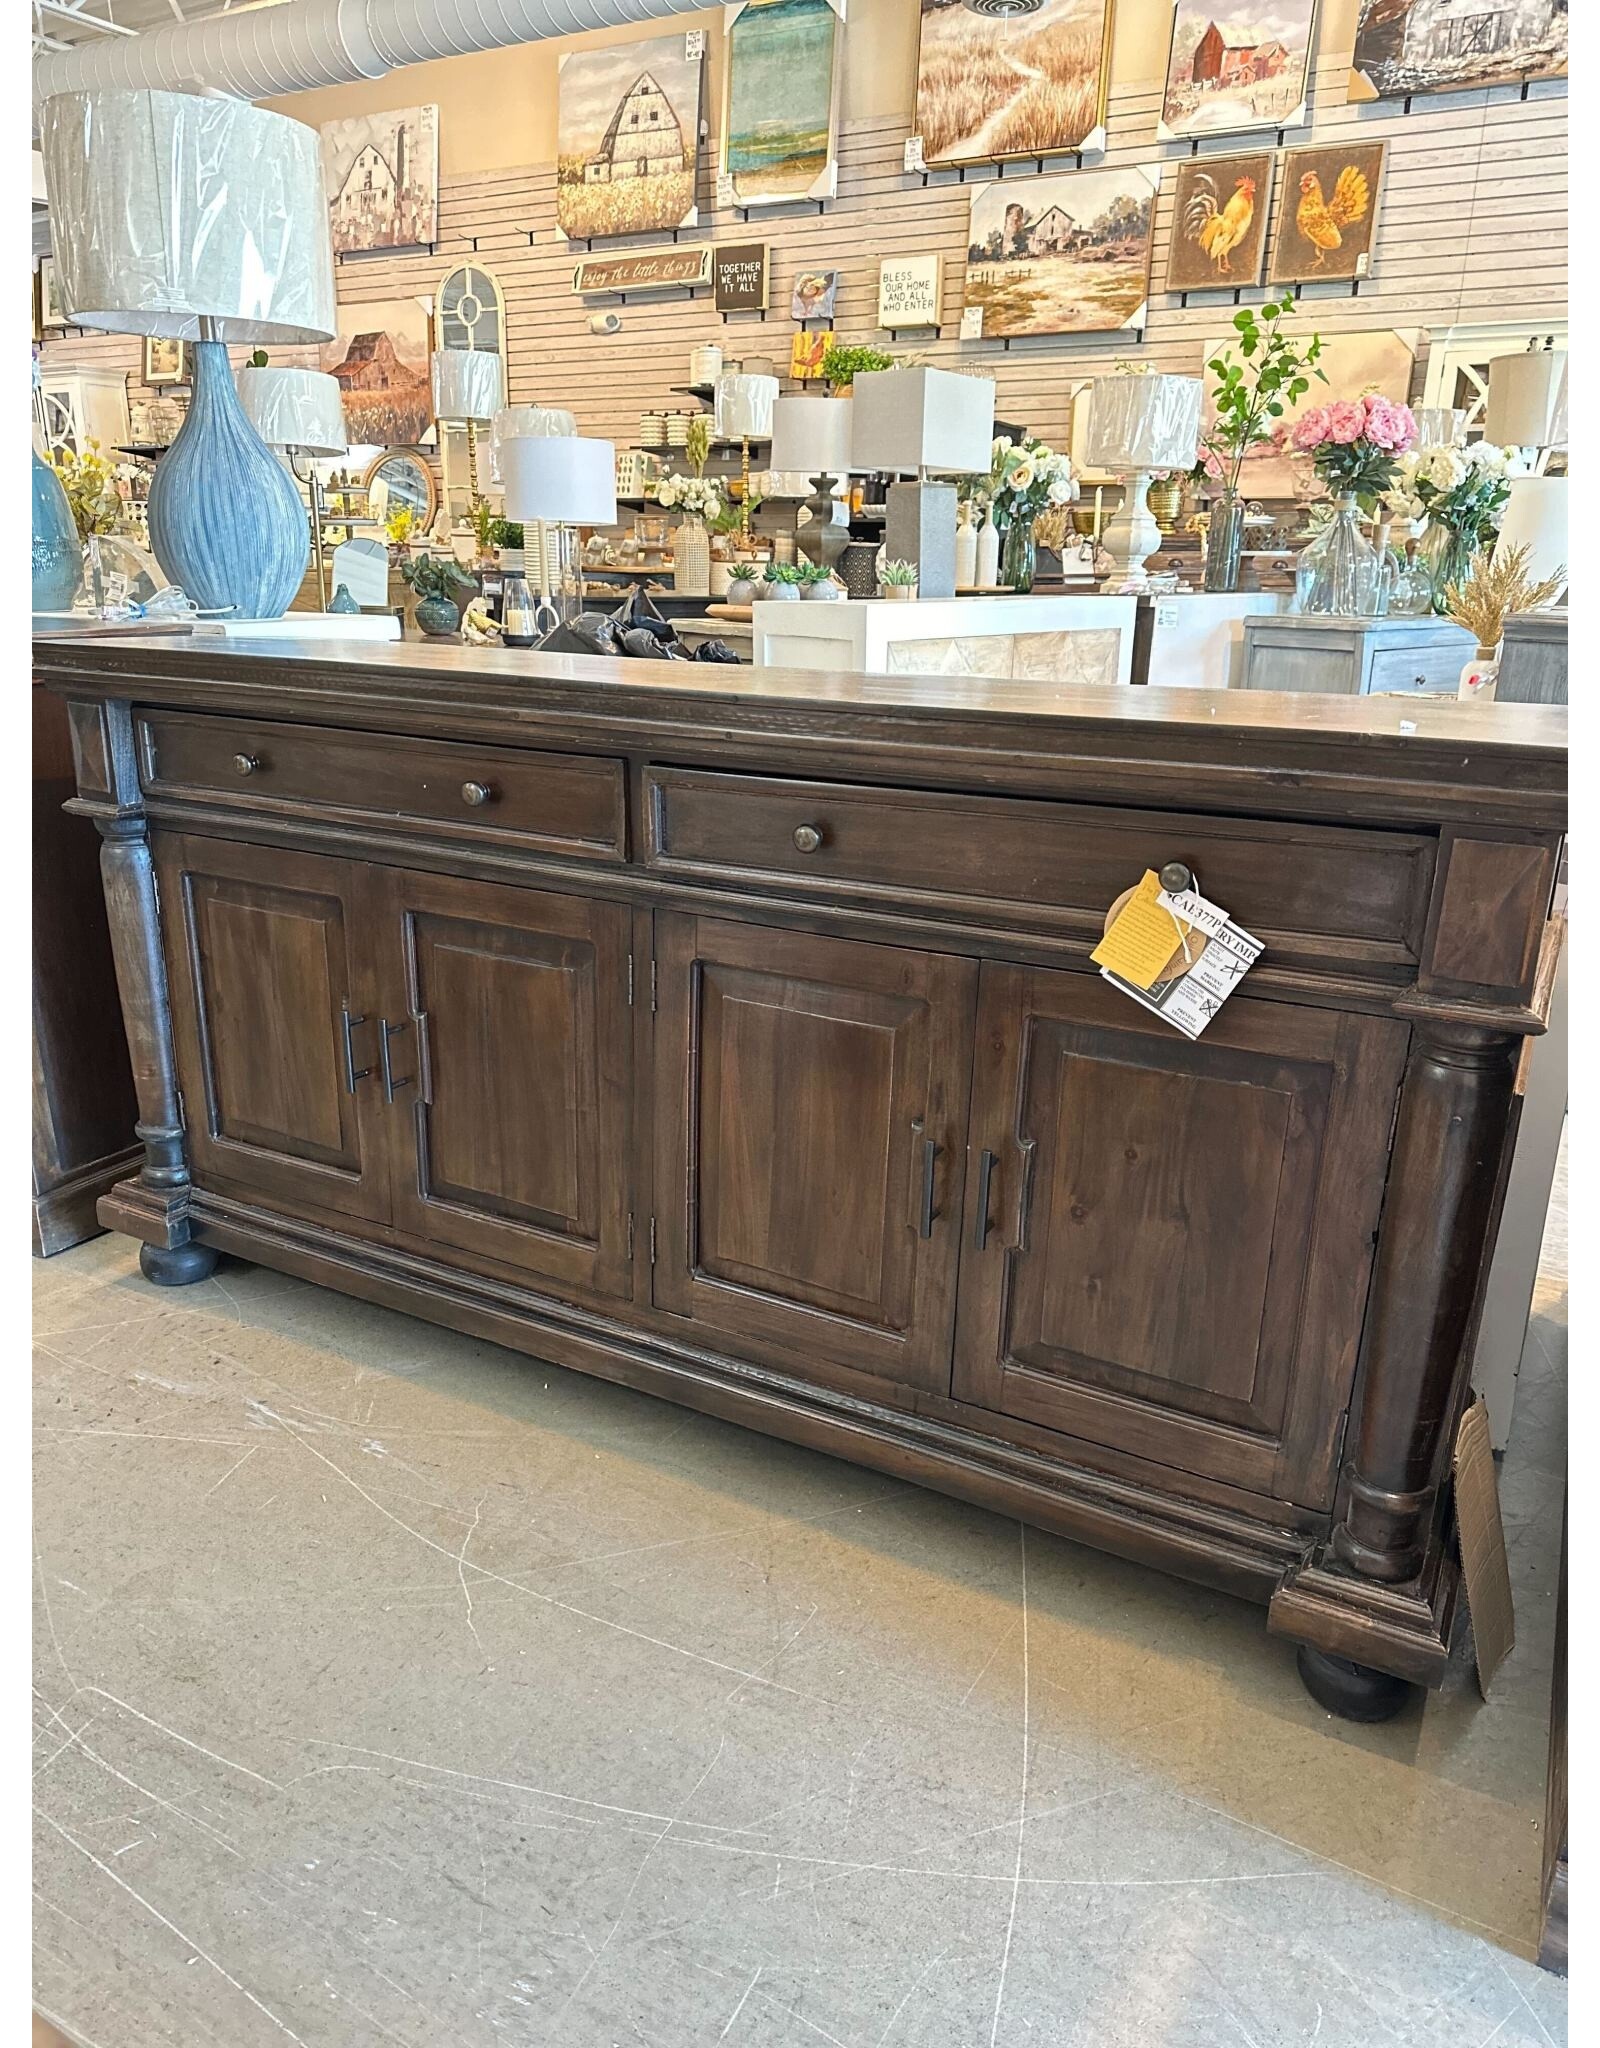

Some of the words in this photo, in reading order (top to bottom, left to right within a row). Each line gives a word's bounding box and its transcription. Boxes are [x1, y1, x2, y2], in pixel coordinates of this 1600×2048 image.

[719, 262, 760, 273] TOGETHER
[583, 272, 608, 286] enjoy
[612, 267, 629, 281] the
[633, 261, 659, 277] little
[663, 261, 696, 277] things
[722, 275, 731, 284] WE
[737, 273, 758, 282] HAVE
[883, 271, 912, 282] BLESS
[725, 284, 734, 293] IT
[739, 283, 755, 292] ALL
[886, 283, 903, 292] OUR
[907, 280, 931, 290] HOME
[888, 292, 905, 301] AND
[883, 302, 900, 311] WHO
[905, 300, 934, 310] ENTER
